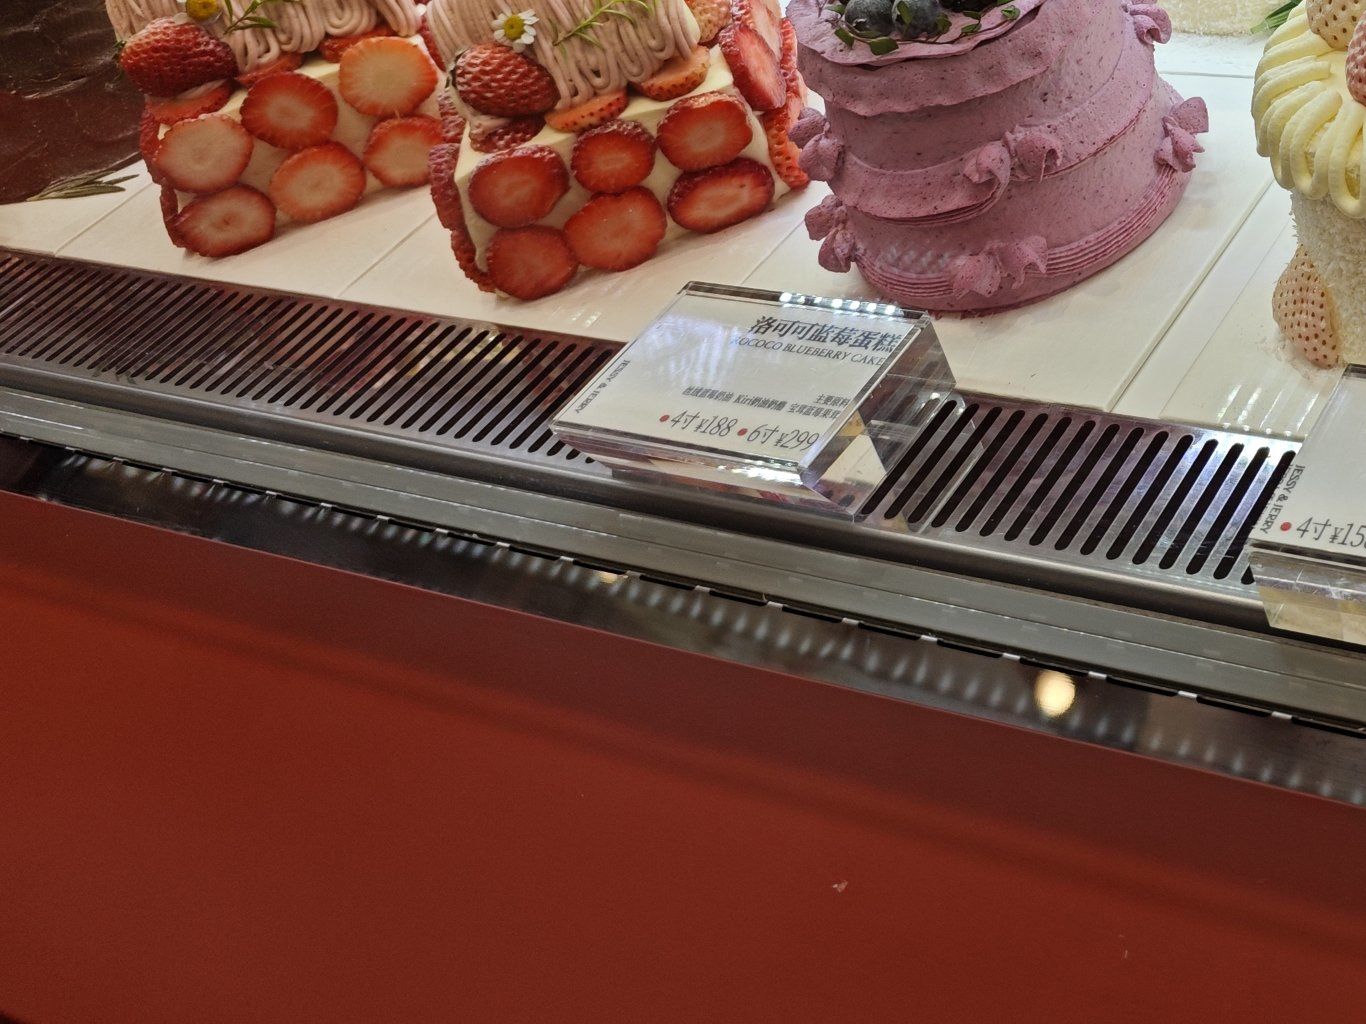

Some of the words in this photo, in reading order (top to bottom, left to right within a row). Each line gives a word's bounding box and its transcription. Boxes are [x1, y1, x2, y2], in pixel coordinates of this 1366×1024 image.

[749, 315, 902, 353] 洛可可蓝莓蛋糕
[782, 343, 851, 360] BLUEBERRY
[850, 353, 886, 367] CAKE
[1283, 465, 1306, 493] JESSY
[1260, 504, 1283, 534] JERRY
